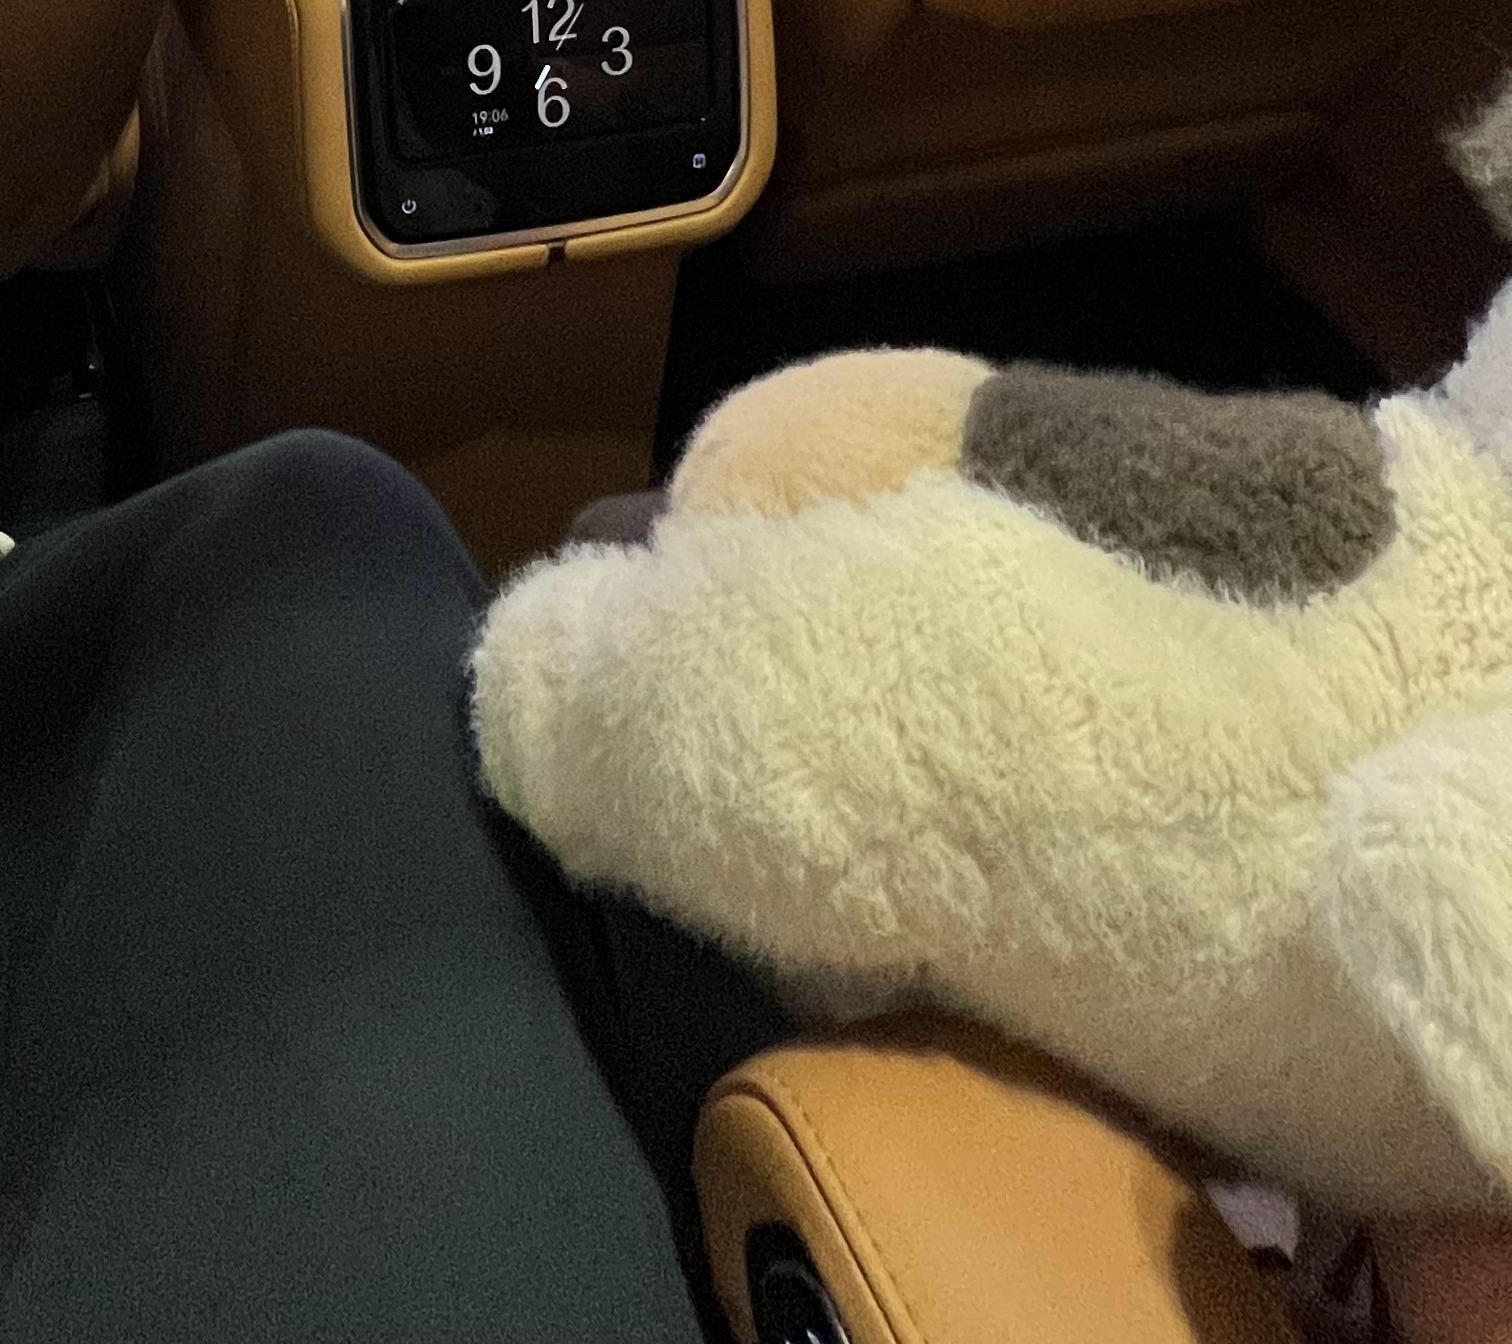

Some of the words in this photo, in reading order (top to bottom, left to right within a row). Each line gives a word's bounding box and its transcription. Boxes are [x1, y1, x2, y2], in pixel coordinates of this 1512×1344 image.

[467, 43, 502, 96] 9
[600, 25, 634, 77] 3
[472, 107, 509, 125] 19:06
[537, 76, 571, 128] 6
